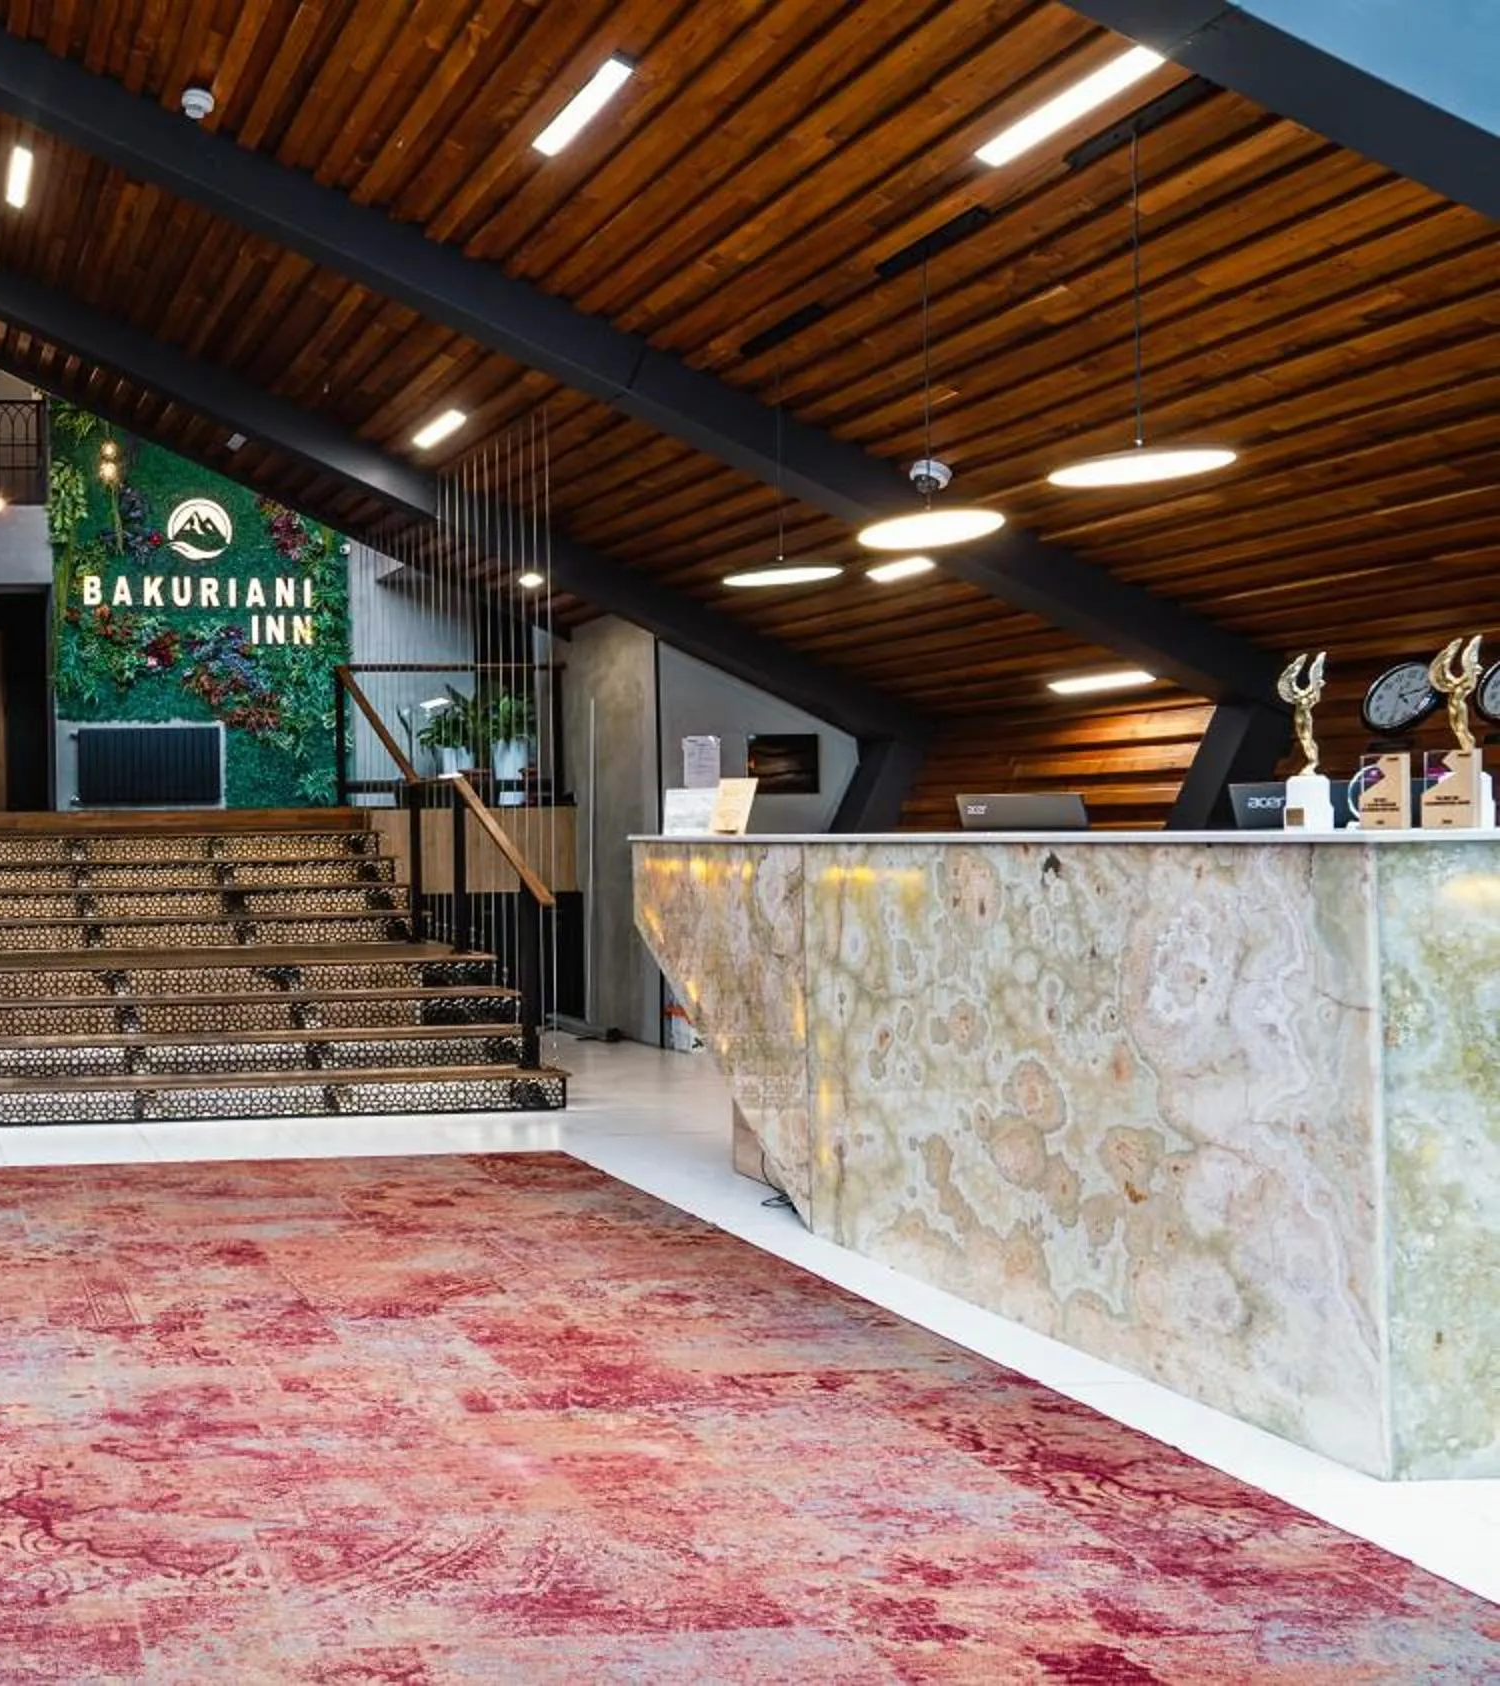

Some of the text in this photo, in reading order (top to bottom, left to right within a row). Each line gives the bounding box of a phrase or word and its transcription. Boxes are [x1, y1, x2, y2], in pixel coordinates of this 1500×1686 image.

[82, 575, 313, 608] BAKURIANI
[251, 615, 313, 645] INN
[1247, 796, 1285, 809] acer
